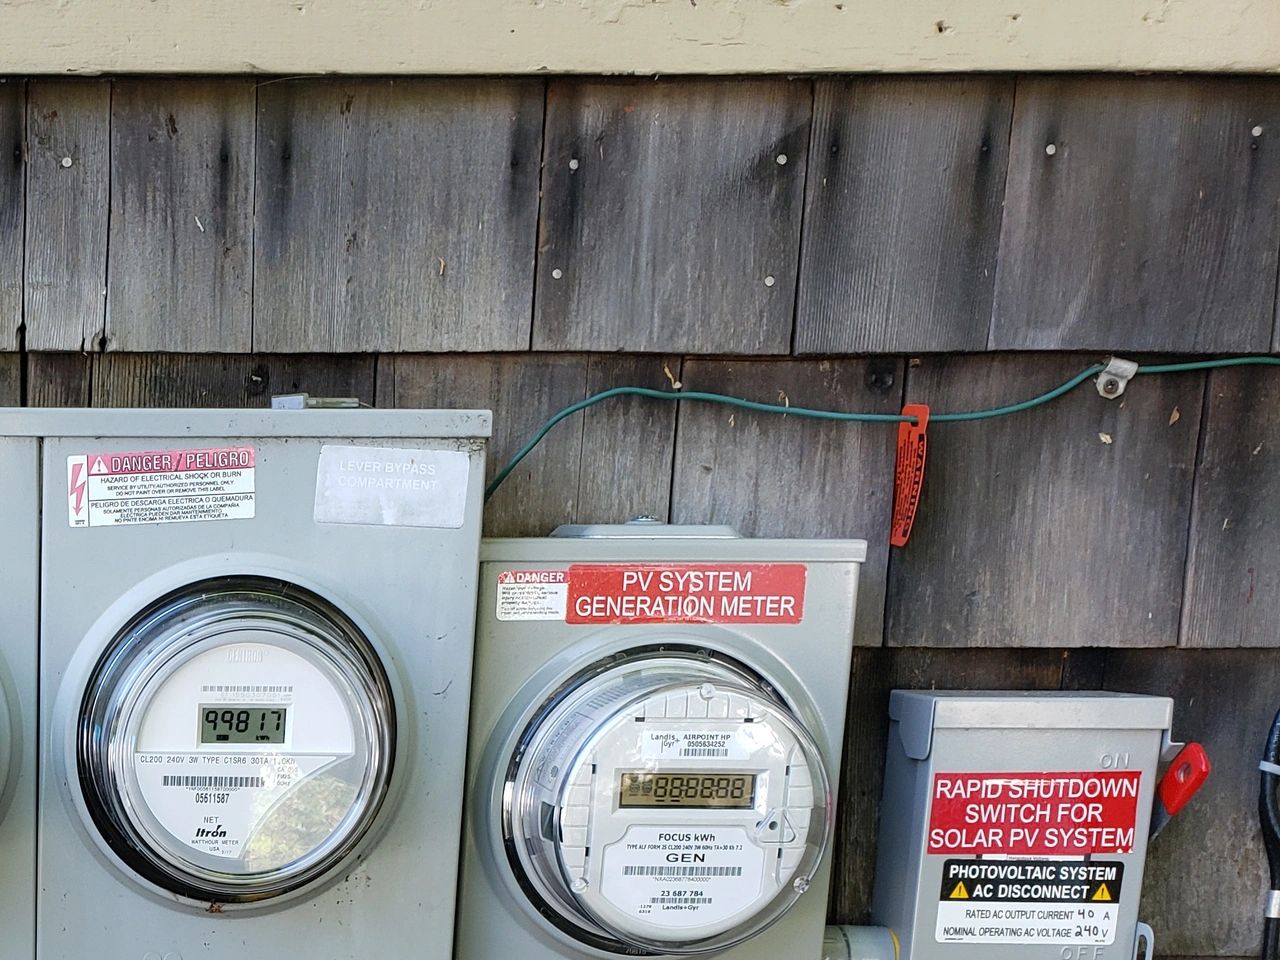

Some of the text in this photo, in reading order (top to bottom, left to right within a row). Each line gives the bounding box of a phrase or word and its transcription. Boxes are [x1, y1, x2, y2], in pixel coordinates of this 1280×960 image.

[111, 454, 171, 472] DANGER
[186, 451, 249, 469] PELIGRO
[340, 460, 436, 475] LEVER BYPASS
[141, 474, 183, 482] ELECTRICAL
[338, 476, 438, 490] COMPARTMENT
[91, 501, 119, 509] PELIGRO
[517, 572, 564, 582] DANGER
[622, 571, 752, 592] PV SYSTEM
[575, 596, 713, 617] GENERATION
[720, 596, 795, 617] METER
[205, 711, 281, 732] 99817
[1098, 752, 1130, 769] ON
[936, 778, 1138, 798] RAPID SHUTDOWN
[195, 793, 230, 803] 05611587
[965, 803, 1103, 823] SWITCH FOR
[930, 828, 1134, 848] SOLAR PV SYSTEM
[666, 853, 705, 862] GEN
[949, 865, 1116, 881] PHOTOVOLTAIC SYSTEM
[972, 884, 1089, 899] AC DISCONNECT
[966, 909, 1110, 920] RATED AC OUTPUT CURRENT 40 A
[943, 925, 1108, 937] NOMINAL OPERATING AC VOLTAGE 240 V
